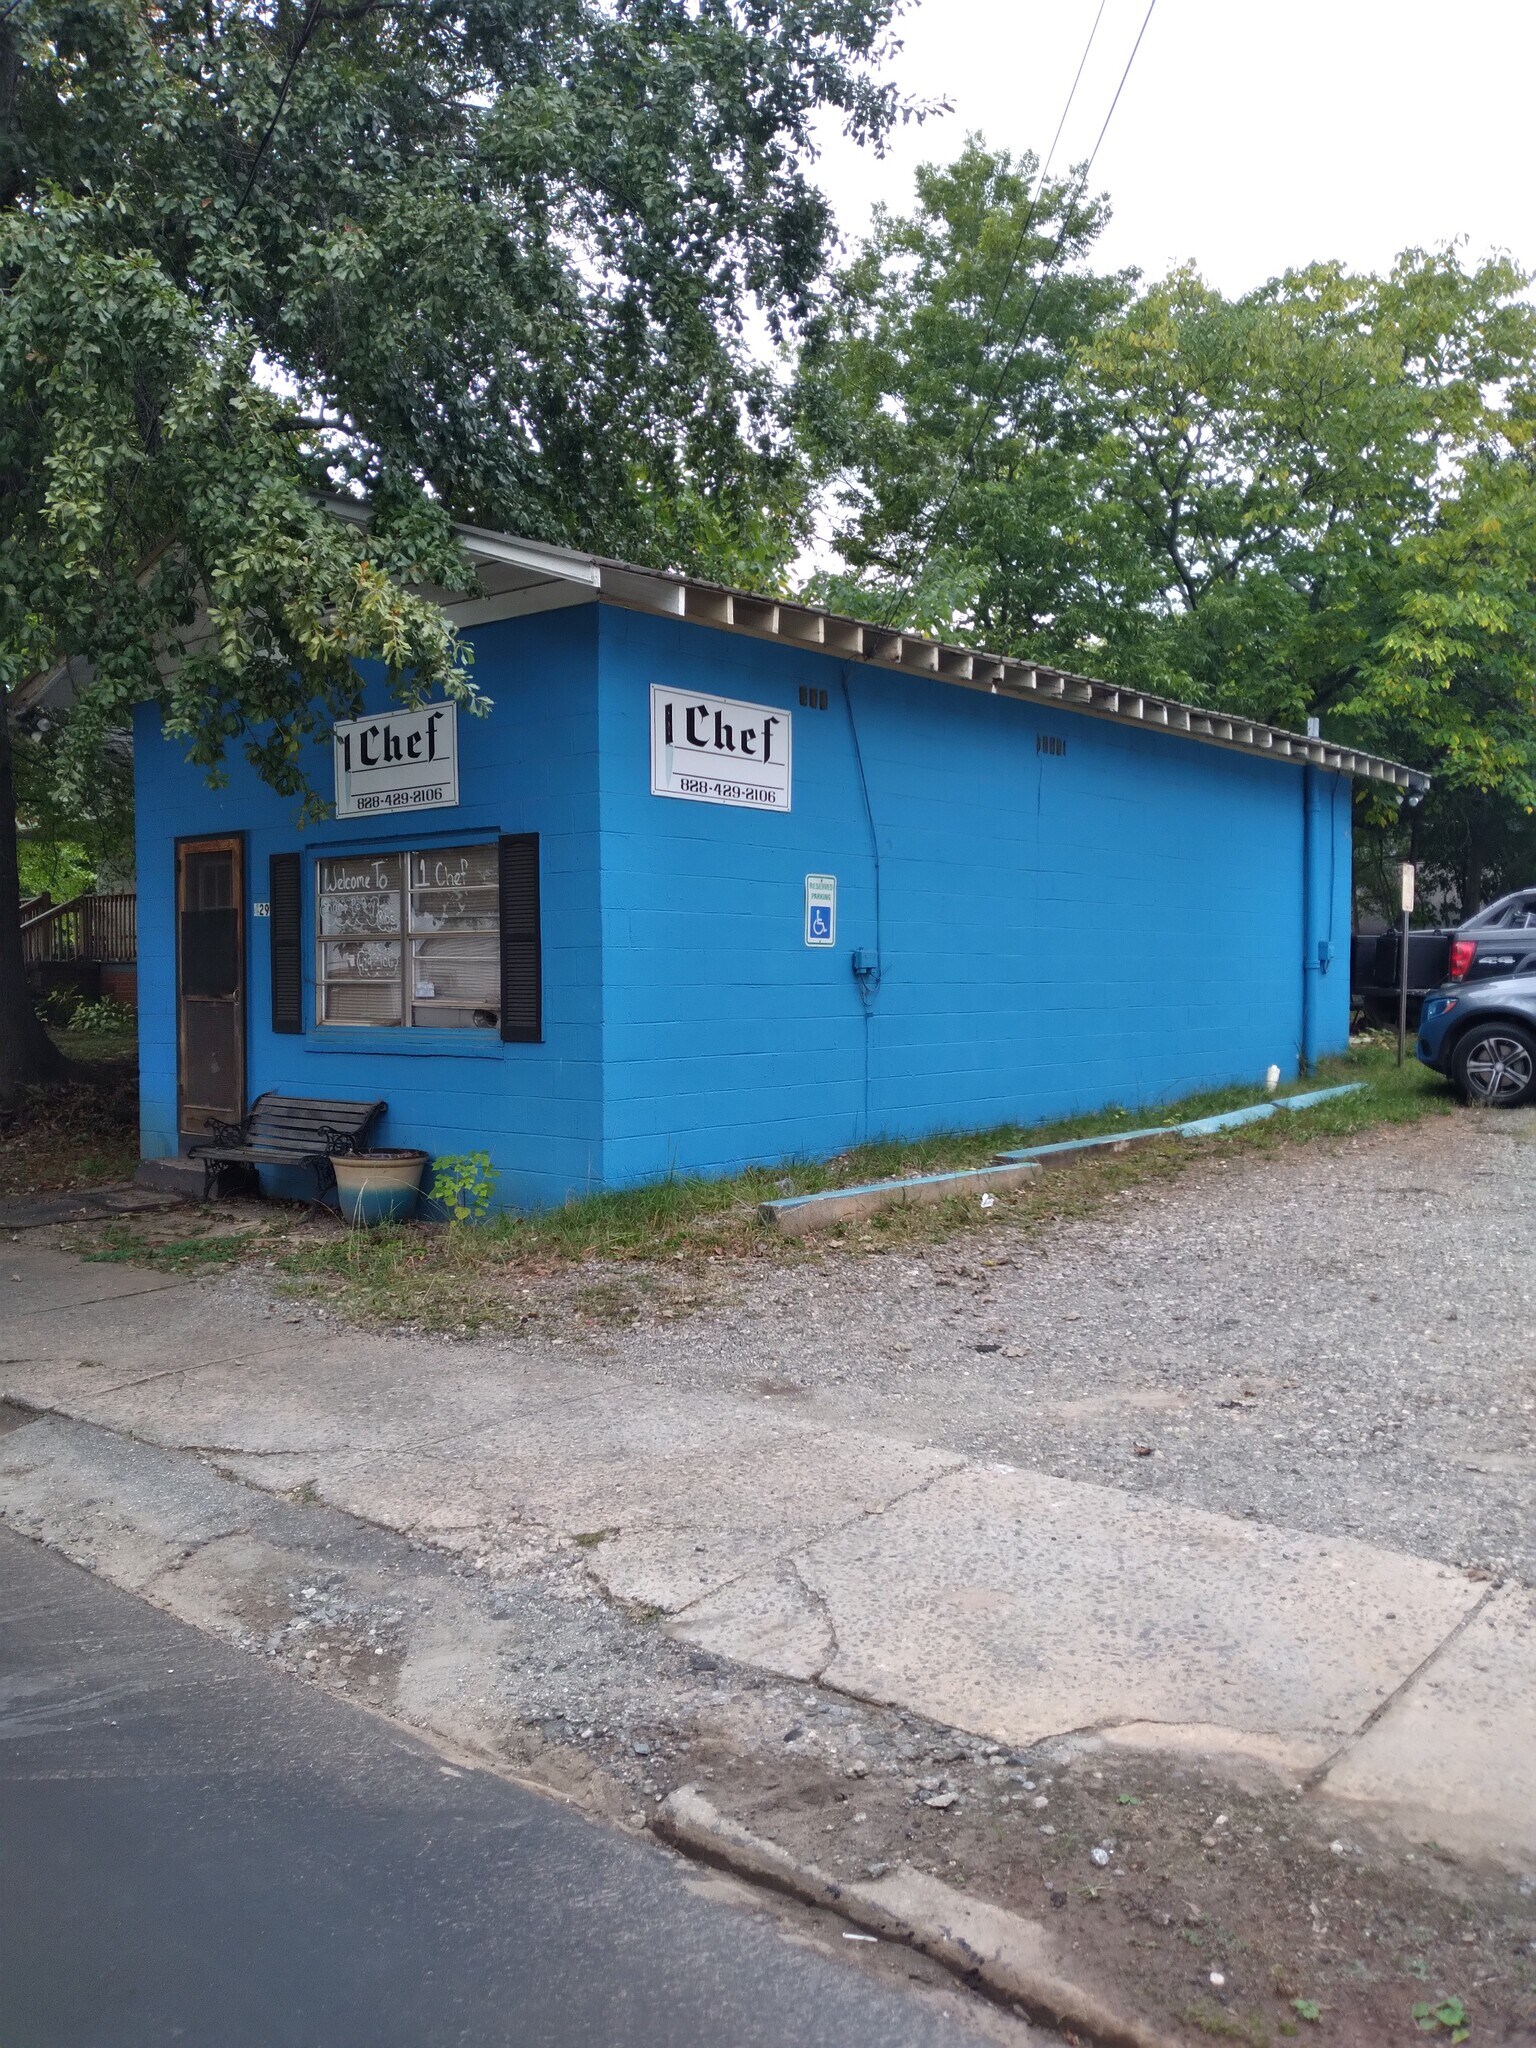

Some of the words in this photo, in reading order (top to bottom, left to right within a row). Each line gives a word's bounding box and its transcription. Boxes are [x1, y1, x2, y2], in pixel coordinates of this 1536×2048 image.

[359, 711, 445, 766] Chef
[685, 704, 780, 765] Chef
[357, 787, 443, 810] 828-429-2106
[680, 778, 776, 803] 828-429-2106
[324, 865, 371, 892] Welcome
[371, 860, 388, 890] To
[414, 858, 430, 887] 1
[435, 857, 469, 886] Chef
[809, 882, 833, 891] RESERVED
[811, 893, 831, 901] PARKING
